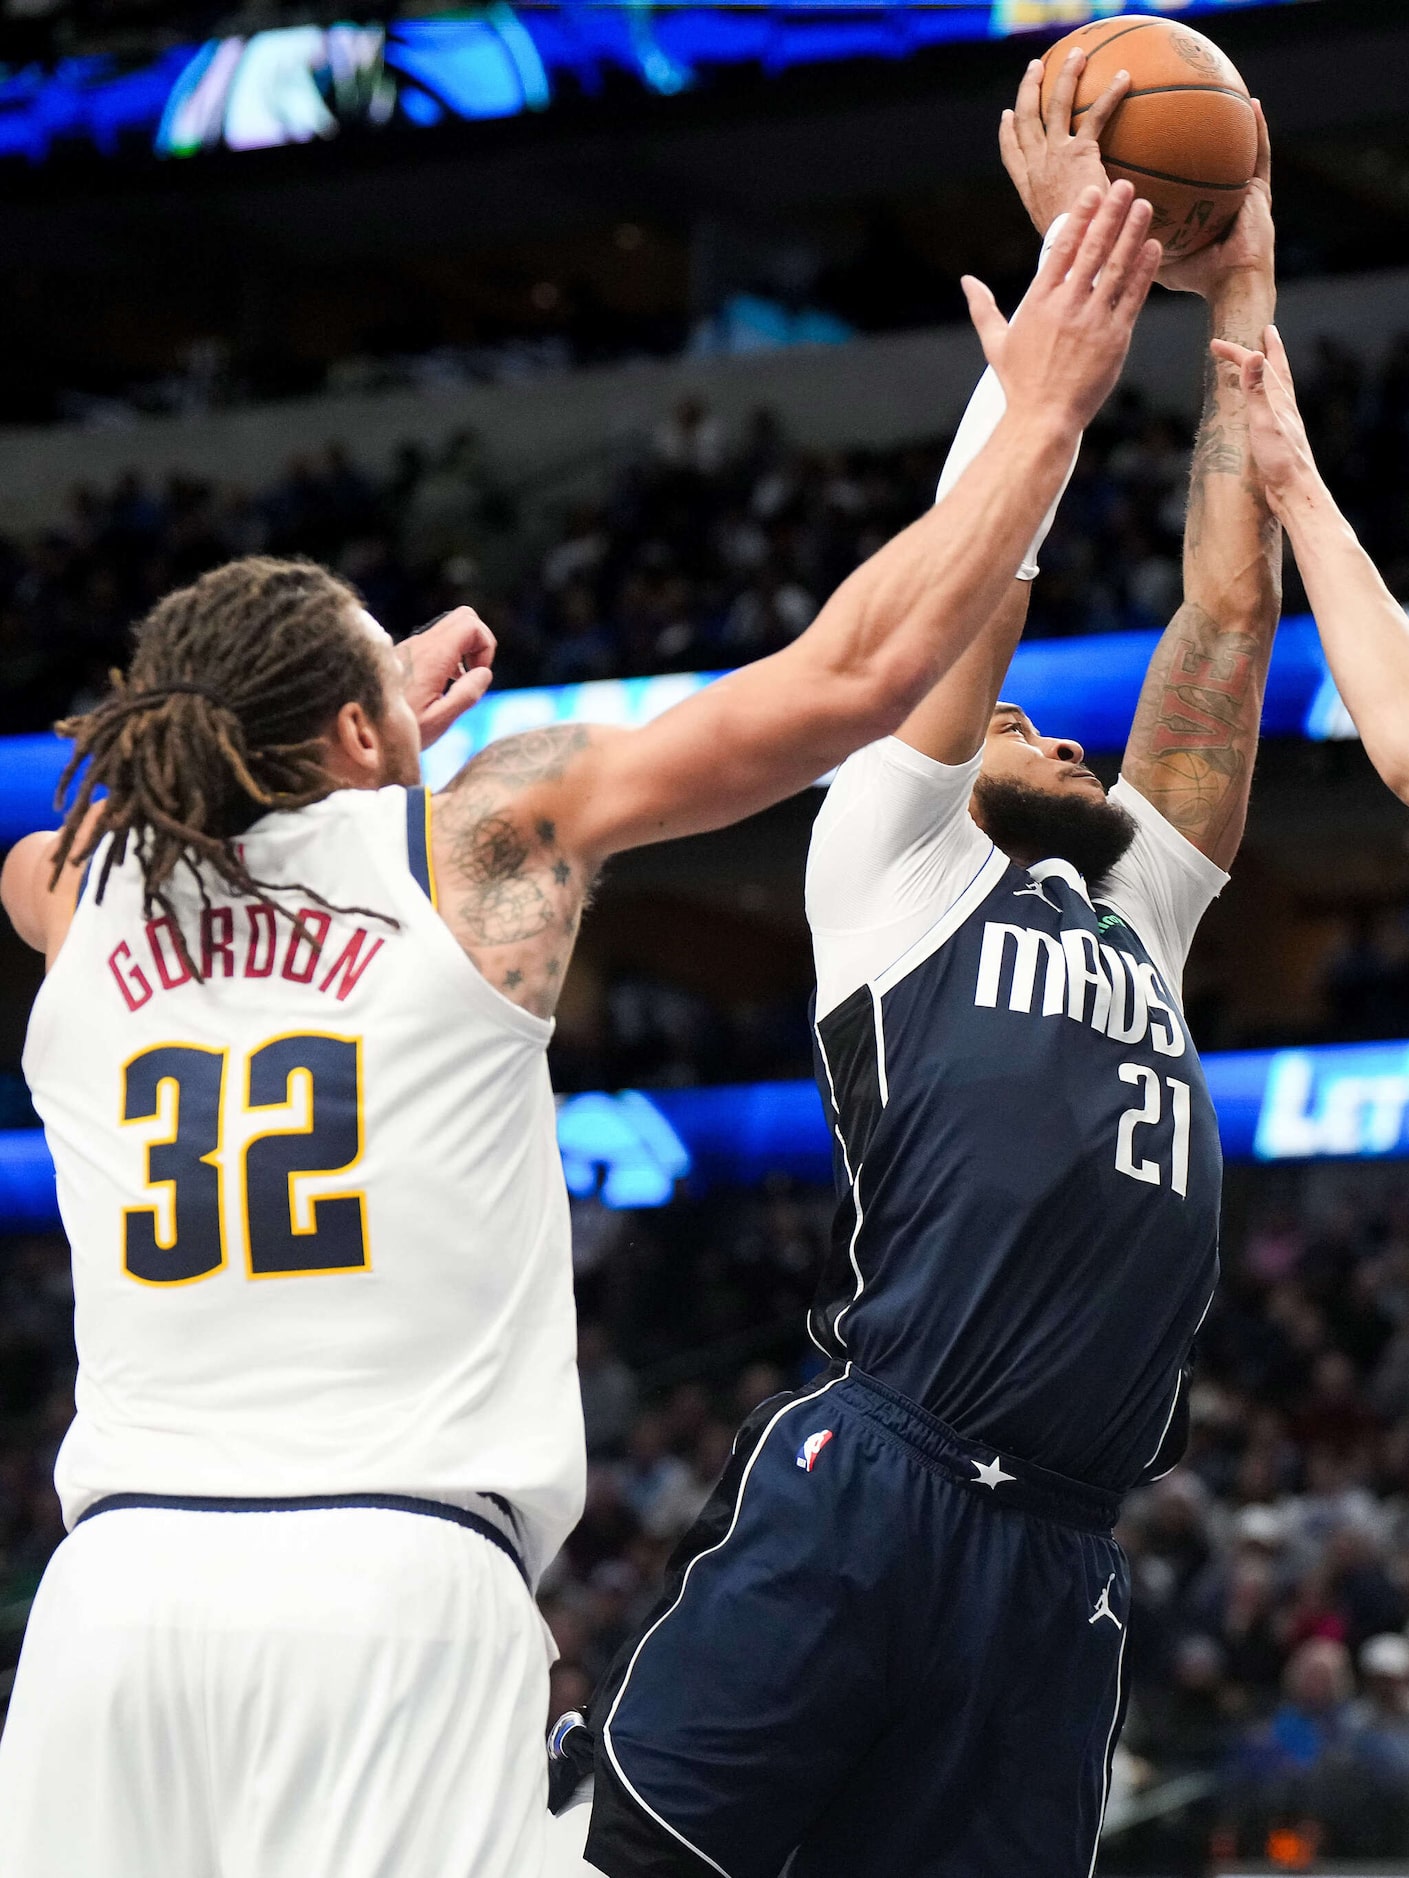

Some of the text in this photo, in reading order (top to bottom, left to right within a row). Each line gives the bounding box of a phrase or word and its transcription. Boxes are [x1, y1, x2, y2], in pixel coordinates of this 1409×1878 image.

[108, 903, 385, 1012] GORDON
[974, 921, 1186, 1058] MAVS
[119, 1029, 374, 1288] 32
[1115, 1063, 1190, 1198] 21
